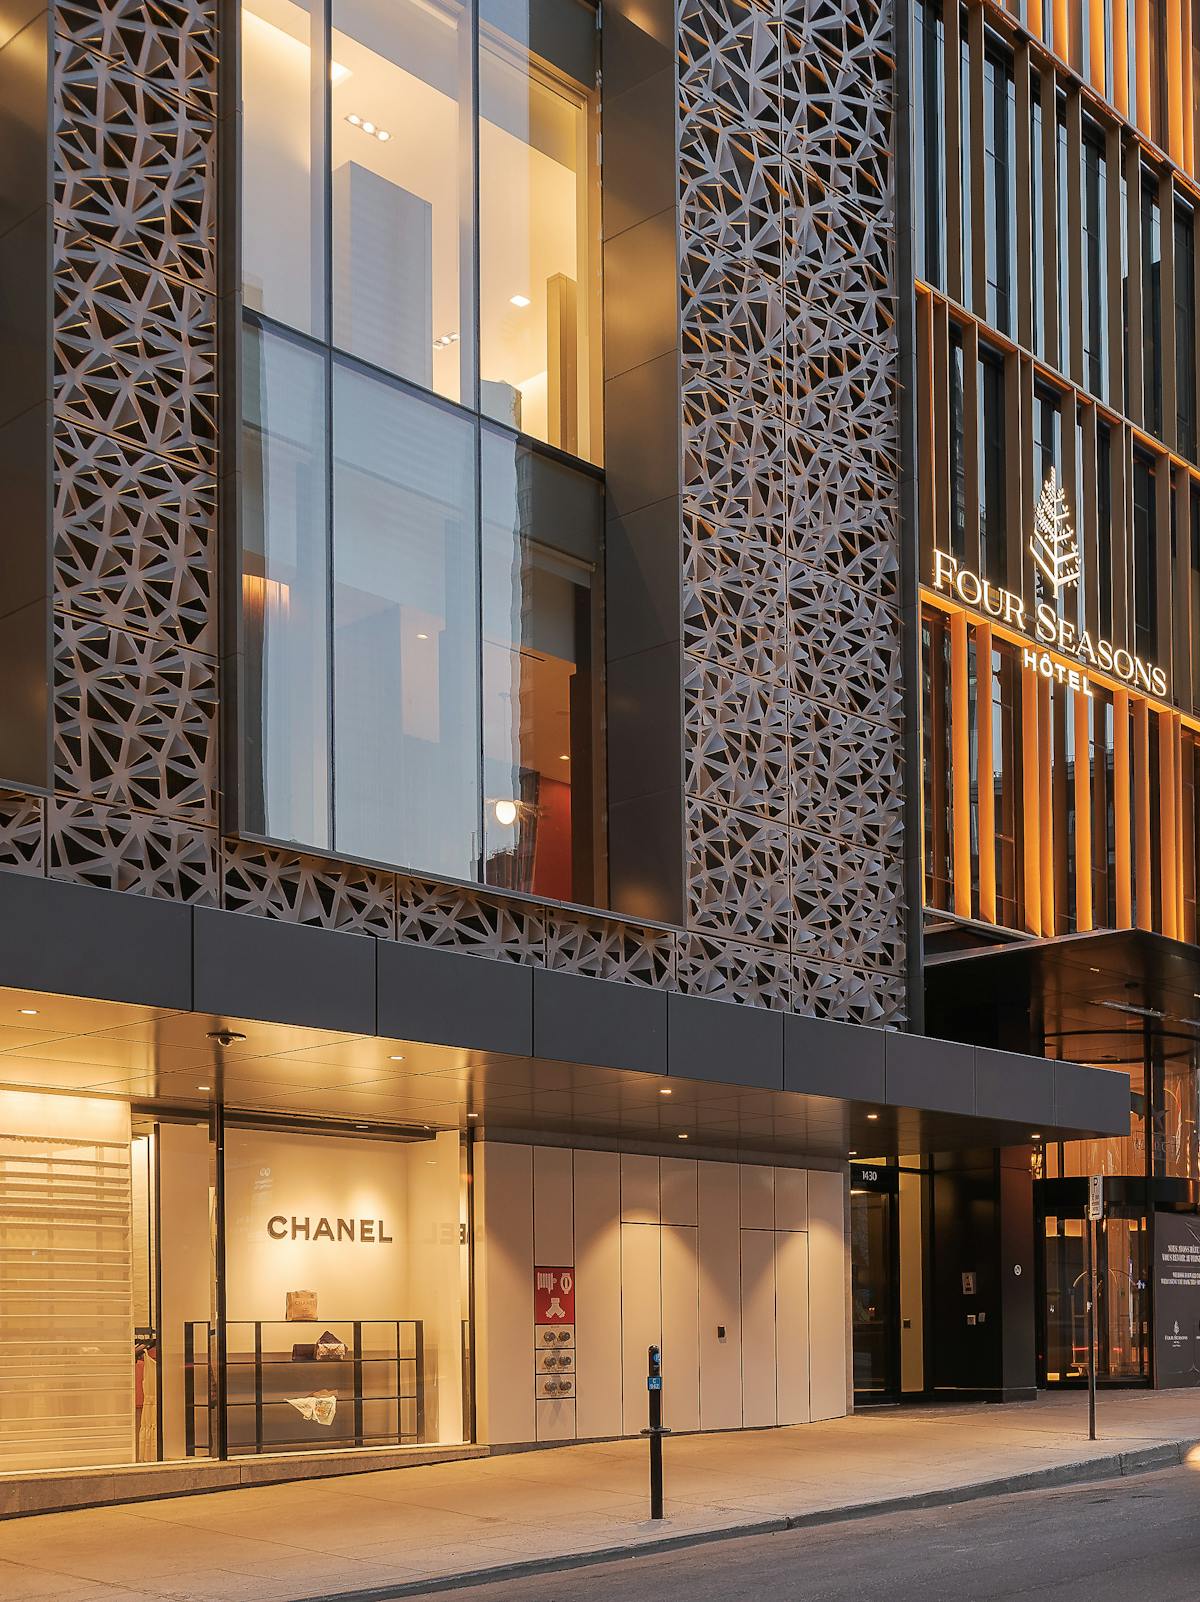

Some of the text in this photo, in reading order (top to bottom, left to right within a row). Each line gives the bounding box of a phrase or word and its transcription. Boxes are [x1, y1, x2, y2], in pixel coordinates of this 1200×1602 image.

[932, 548, 1167, 697] FOUR SEASONS
[1023, 648, 1094, 698] HÔTEL
[862, 1170, 878, 1181] 1430
[267, 1215, 393, 1244] CHANEL
